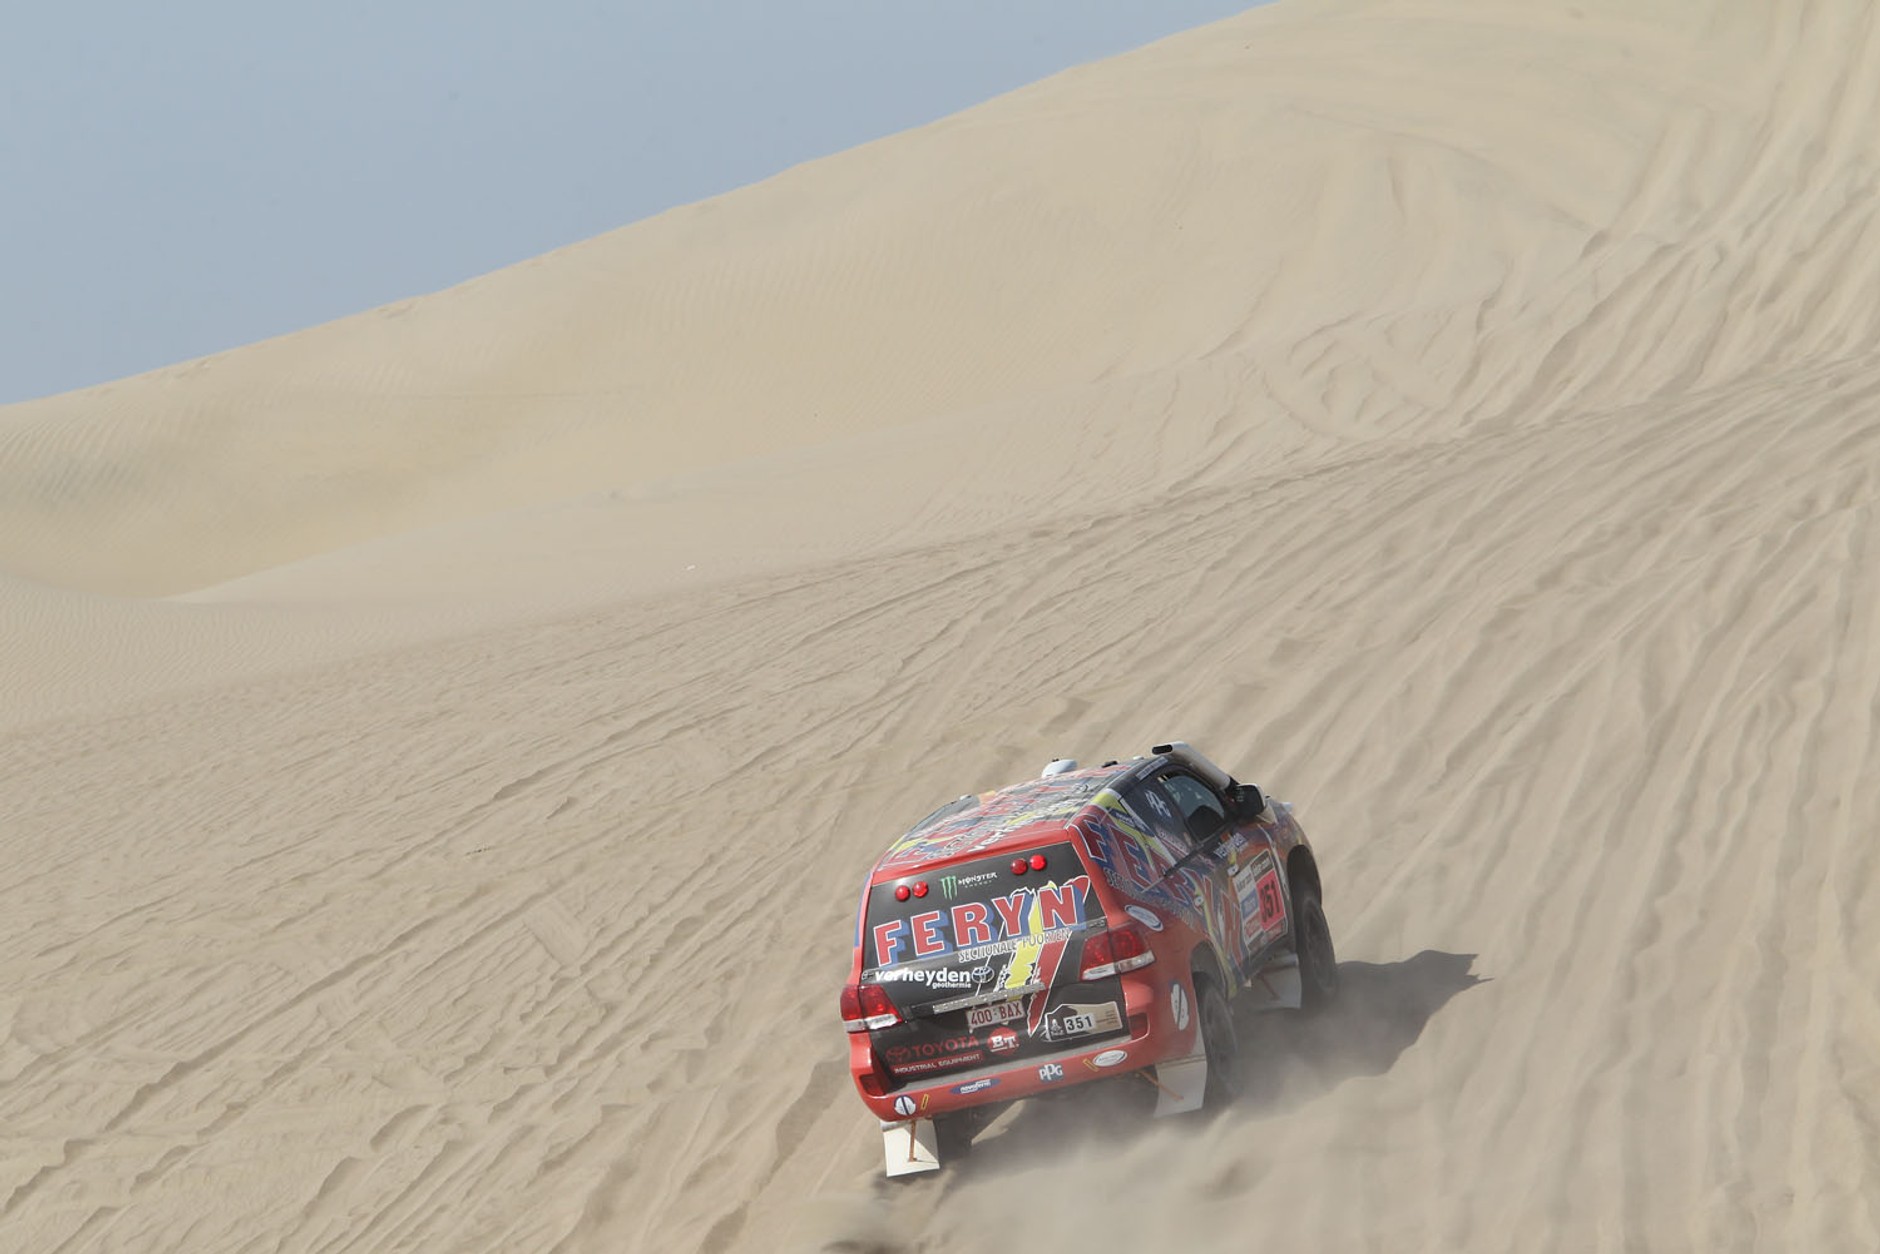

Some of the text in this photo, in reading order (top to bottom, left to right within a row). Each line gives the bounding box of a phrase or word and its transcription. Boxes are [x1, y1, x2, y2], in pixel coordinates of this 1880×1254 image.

[958, 872, 998, 885] MONSTER
[1260, 880, 1281, 923] 351
[873, 884, 1087, 968] FERYN
[875, 966, 972, 987] verheyden
[1066, 1016, 1092, 1031] 351
[912, 1036, 980, 1058] TOYOTA
[894, 1062, 936, 1074] INDUSTRIAL
[1038, 1063, 1064, 1082] PPG
